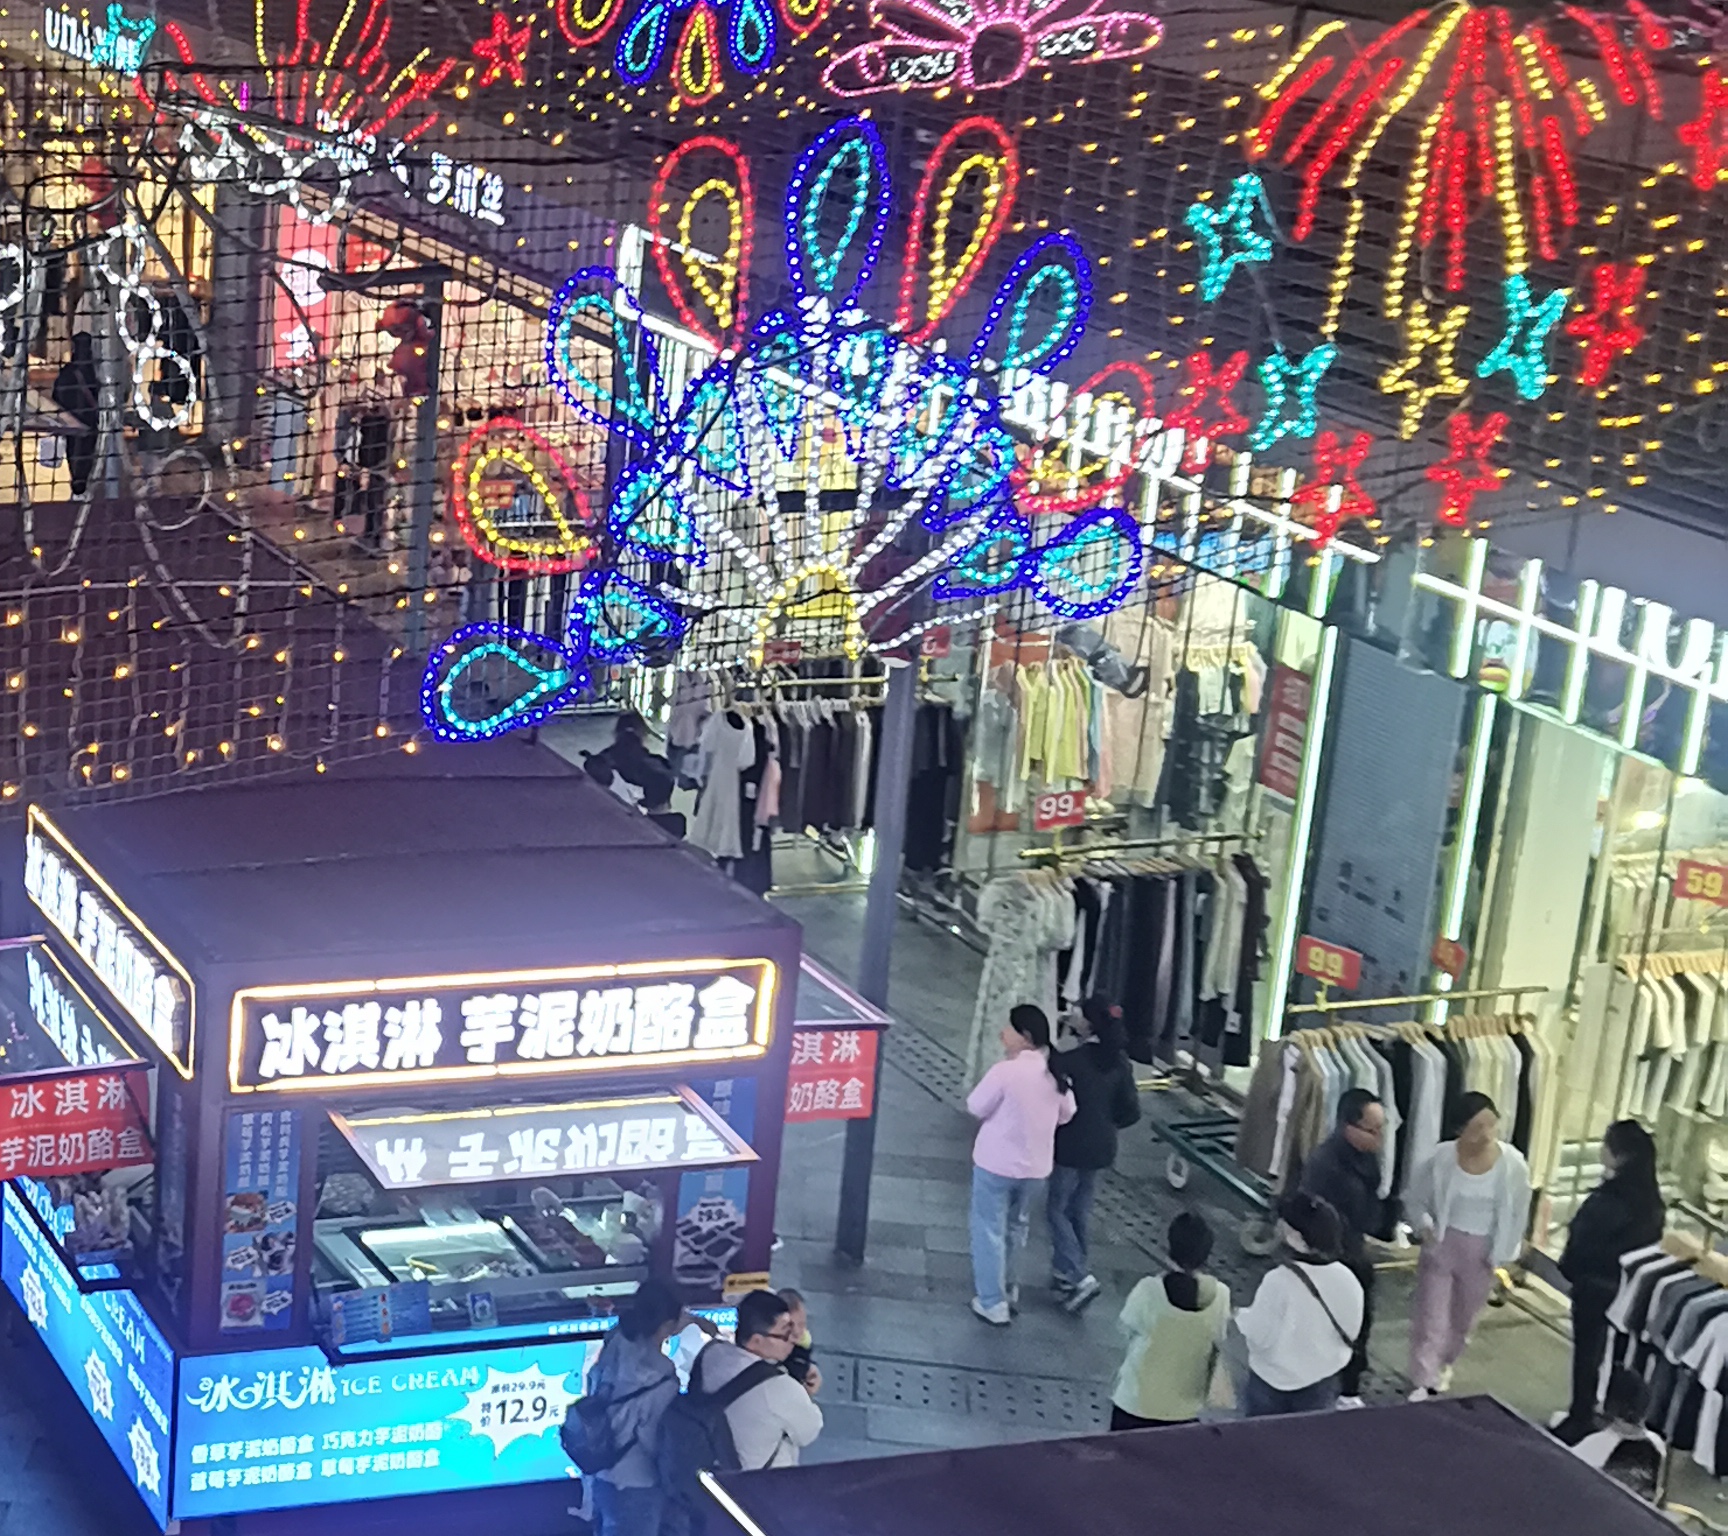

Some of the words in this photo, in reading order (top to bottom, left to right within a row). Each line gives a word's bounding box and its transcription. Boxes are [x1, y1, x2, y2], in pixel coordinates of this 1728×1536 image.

[1039, 794, 1074, 821] 99
[1685, 868, 1723, 898] 59
[1308, 946, 1344, 979] 99
[258, 998, 443, 1078] 冰淇淋
[459, 975, 756, 1064] 芋泥奶酪盒
[10, 1077, 132, 1120] 冰淇淋
[0, 1126, 146, 1173] 芋泥奶酪盒
[185, 1365, 338, 1413] 冰淇淋
[340, 1375, 382, 1397] ICE
[391, 1366, 480, 1393] CREAM
